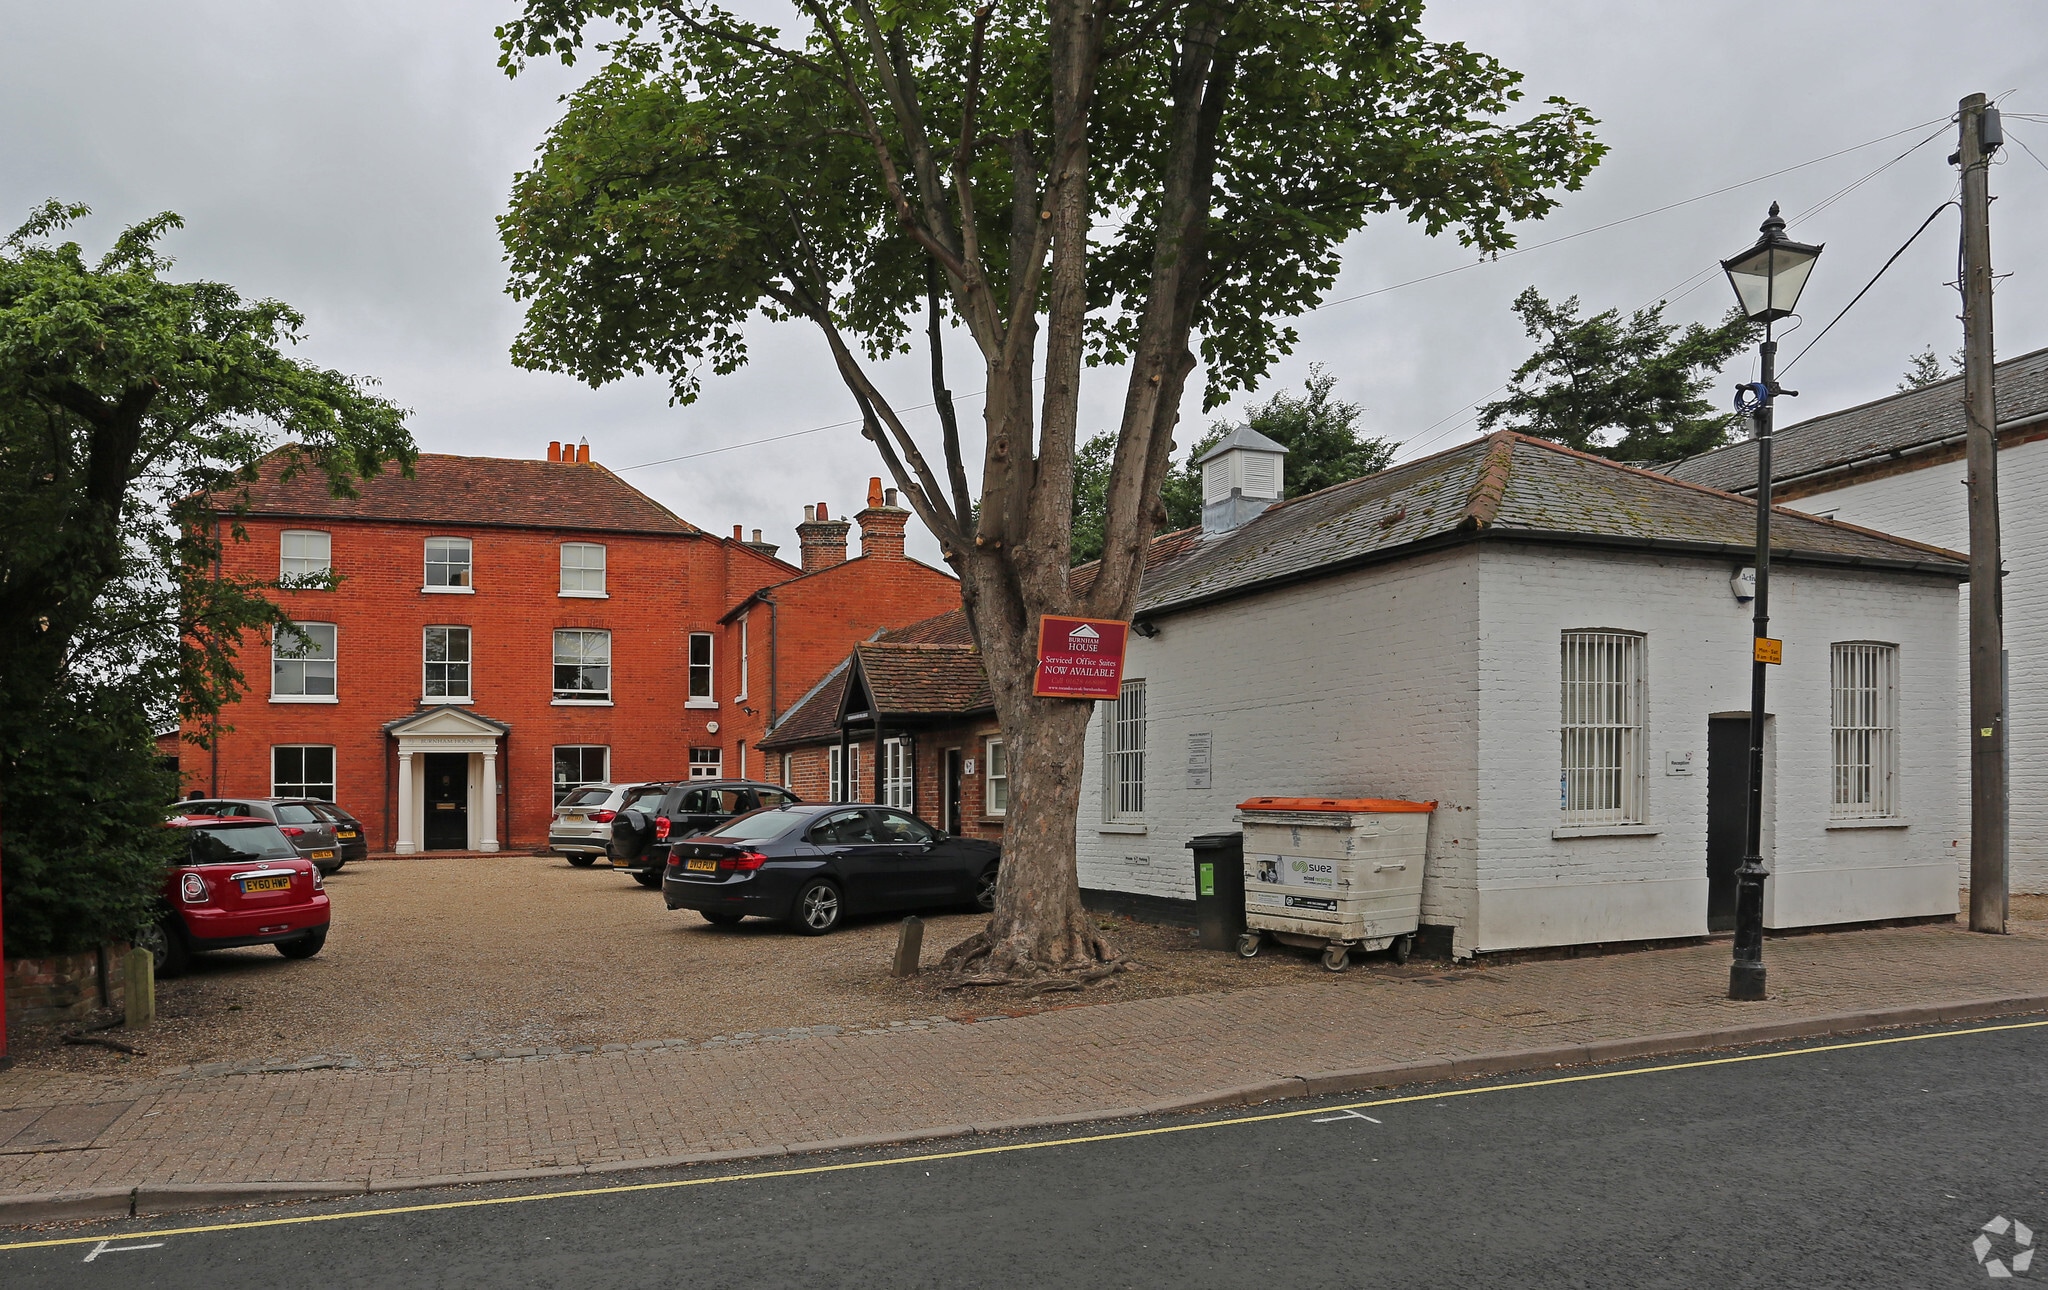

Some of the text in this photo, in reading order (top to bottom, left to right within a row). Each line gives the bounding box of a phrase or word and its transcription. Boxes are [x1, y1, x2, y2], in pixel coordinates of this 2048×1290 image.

[1069, 643, 1098, 652] HOUSE
[1046, 656, 1117, 667] Serviced Office Suites
[1045, 665, 1115, 678] NOW AVAILABLE
[1309, 864, 1332, 873] suez
[246, 878, 289, 891] EY60 HWP
